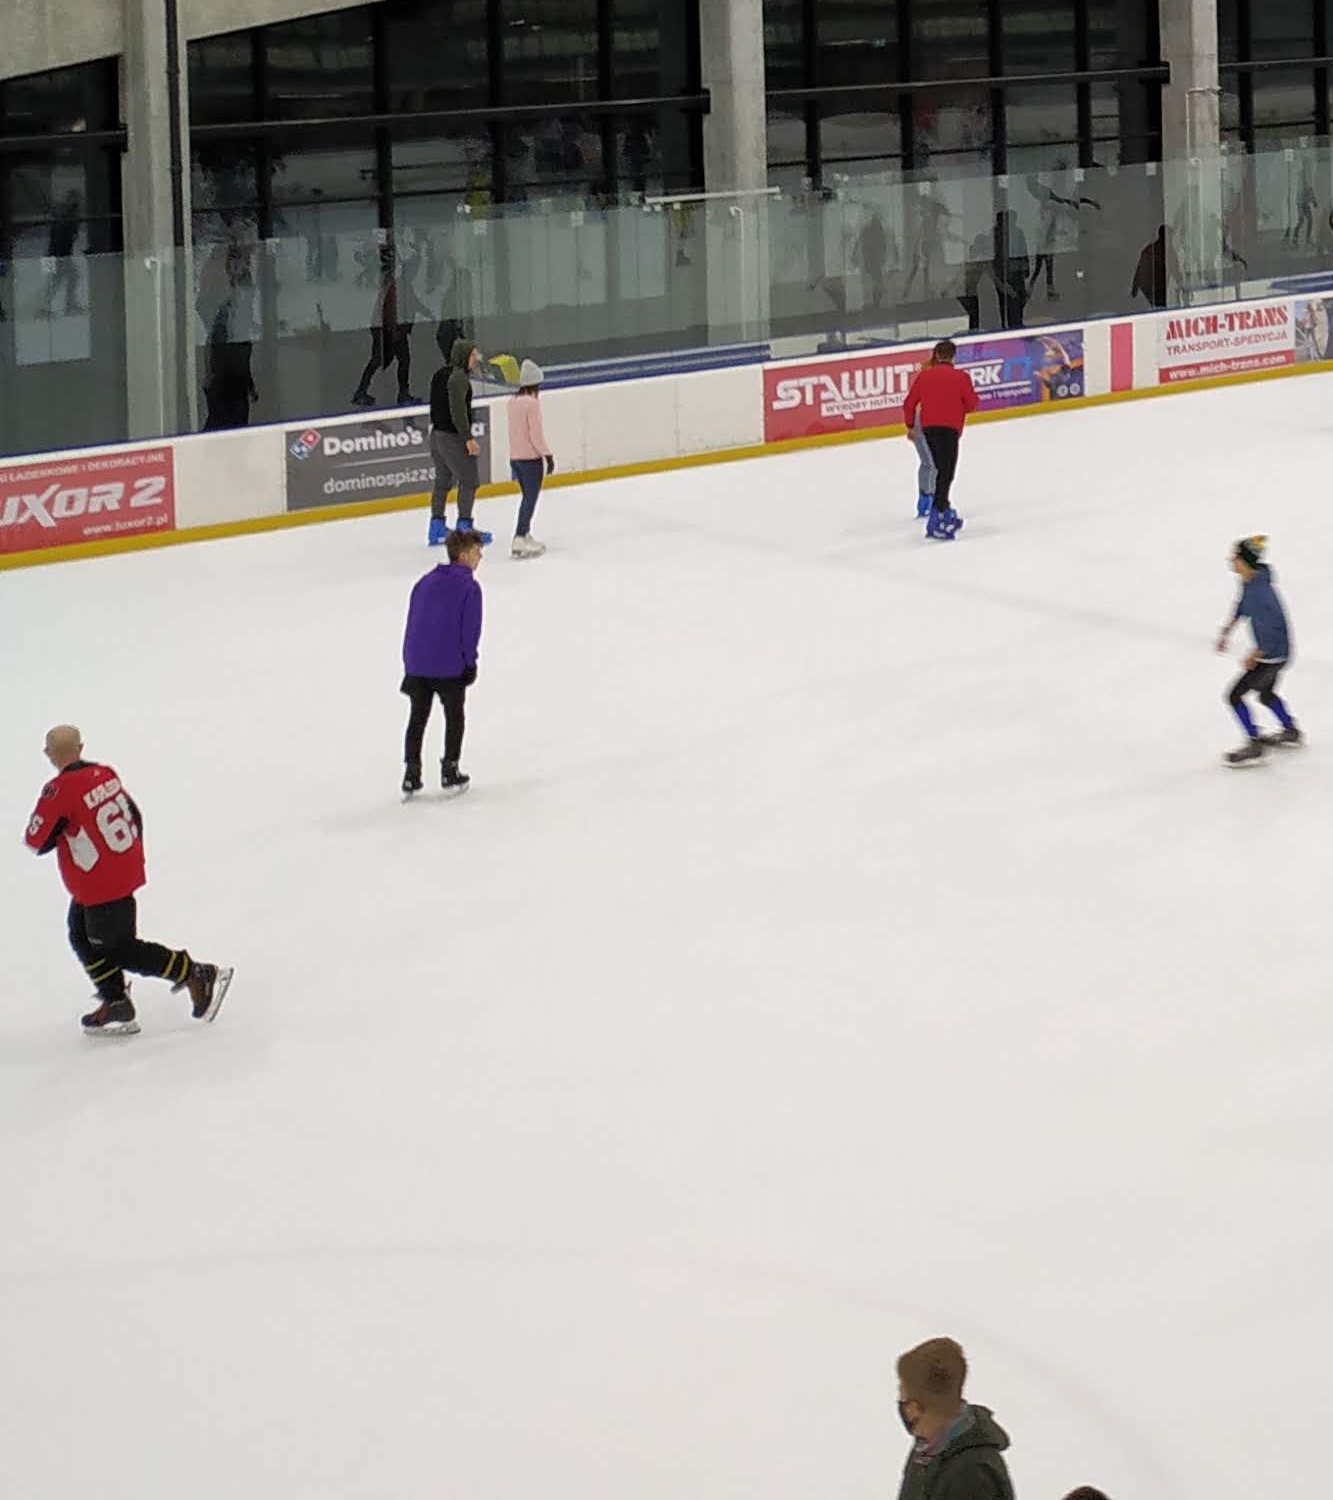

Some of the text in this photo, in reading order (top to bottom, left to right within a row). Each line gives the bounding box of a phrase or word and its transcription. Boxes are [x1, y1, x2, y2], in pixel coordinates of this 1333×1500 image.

[1166, 305, 1289, 341] MICH-TRANS
[1166, 330, 1288, 357] TRANSPORT-SPEDYCJA
[1168, 354, 1286, 380] www.mich-trans.com
[322, 425, 424, 457] Domino's
[129, 475, 167, 509] 2
